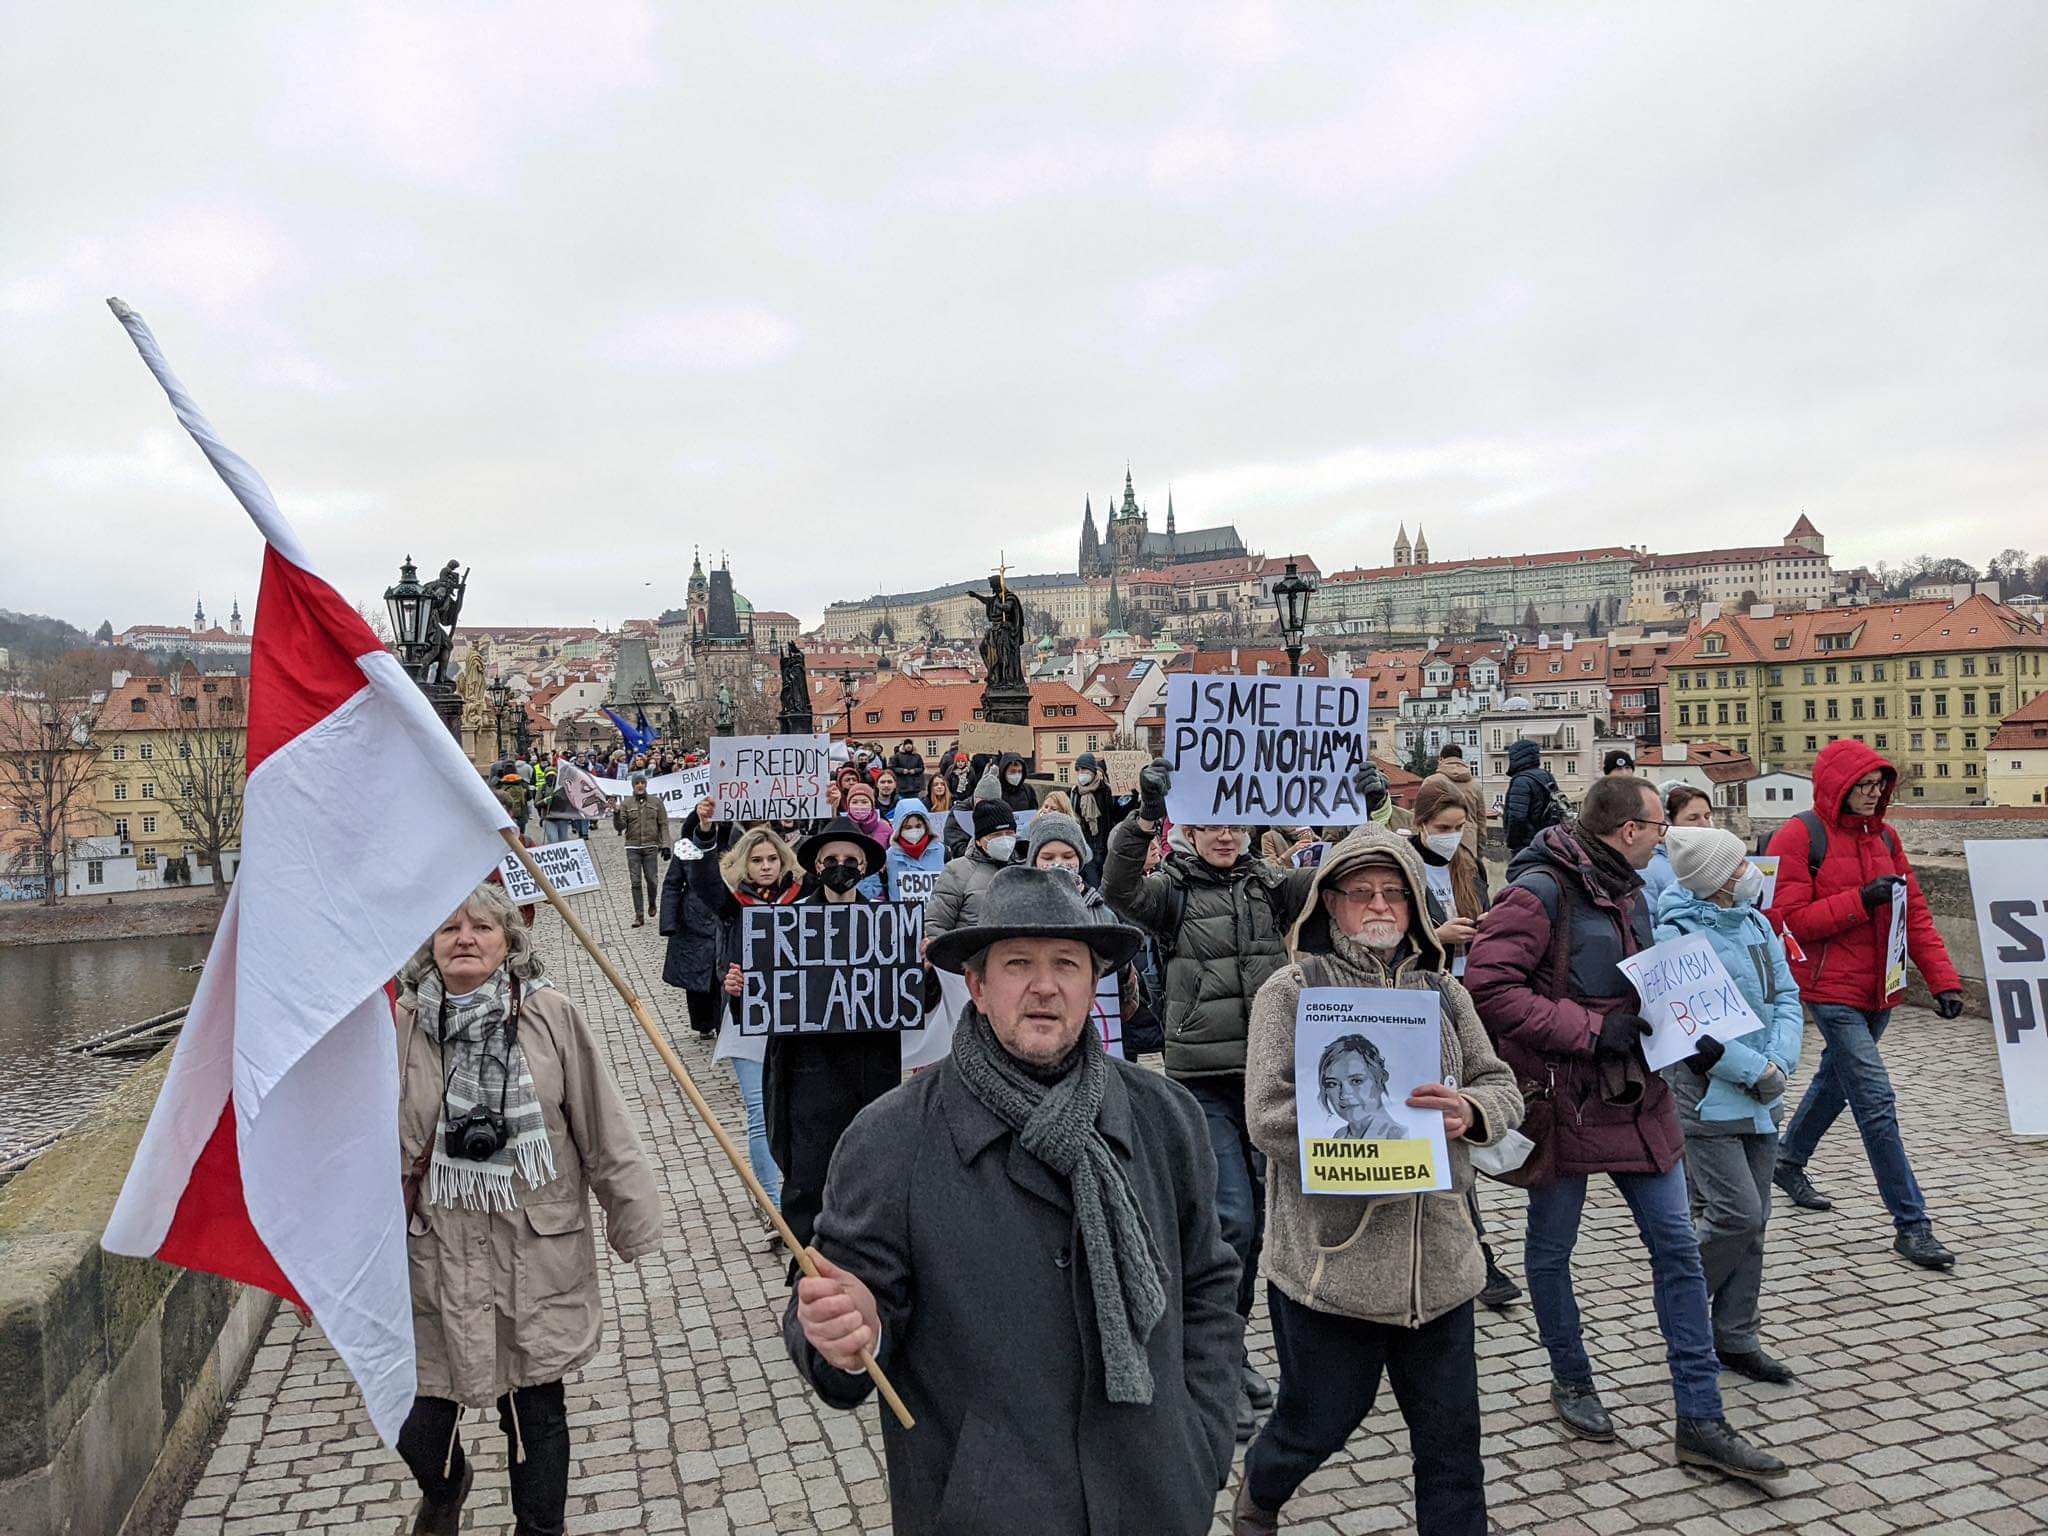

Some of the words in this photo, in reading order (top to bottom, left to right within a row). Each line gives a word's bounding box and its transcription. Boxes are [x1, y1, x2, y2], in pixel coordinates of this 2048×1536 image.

[1175, 680, 1281, 727] JSME
[1296, 684, 1359, 727] LED
[736, 747, 830, 777] FREEDOM
[1175, 726, 1245, 772] POD
[1254, 728, 1364, 773] NOHAMA
[719, 781, 749, 800] FOR
[770, 775, 820, 798] ALES
[1211, 773, 1360, 818] MAJORA
[724, 797, 818, 820] BIALIATSKI
[505, 855, 518, 870] В
[529, 847, 570, 864] ОССИИ
[742, 903, 923, 970] FREEDOM
[1989, 900, 2048, 962] S
[742, 968, 923, 1035] BELARUS
[1305, 1003, 1354, 1013] СВОБОДУ
[1996, 979, 2048, 1044] P
[1305, 1014, 1427, 1025] ПОЛИТЗАКЛЮЧЕННЫМ
[1311, 1143, 1380, 1159] ЛИЛИЯ
[1314, 1164, 1431, 1182] ЧАНЫШЕВА
